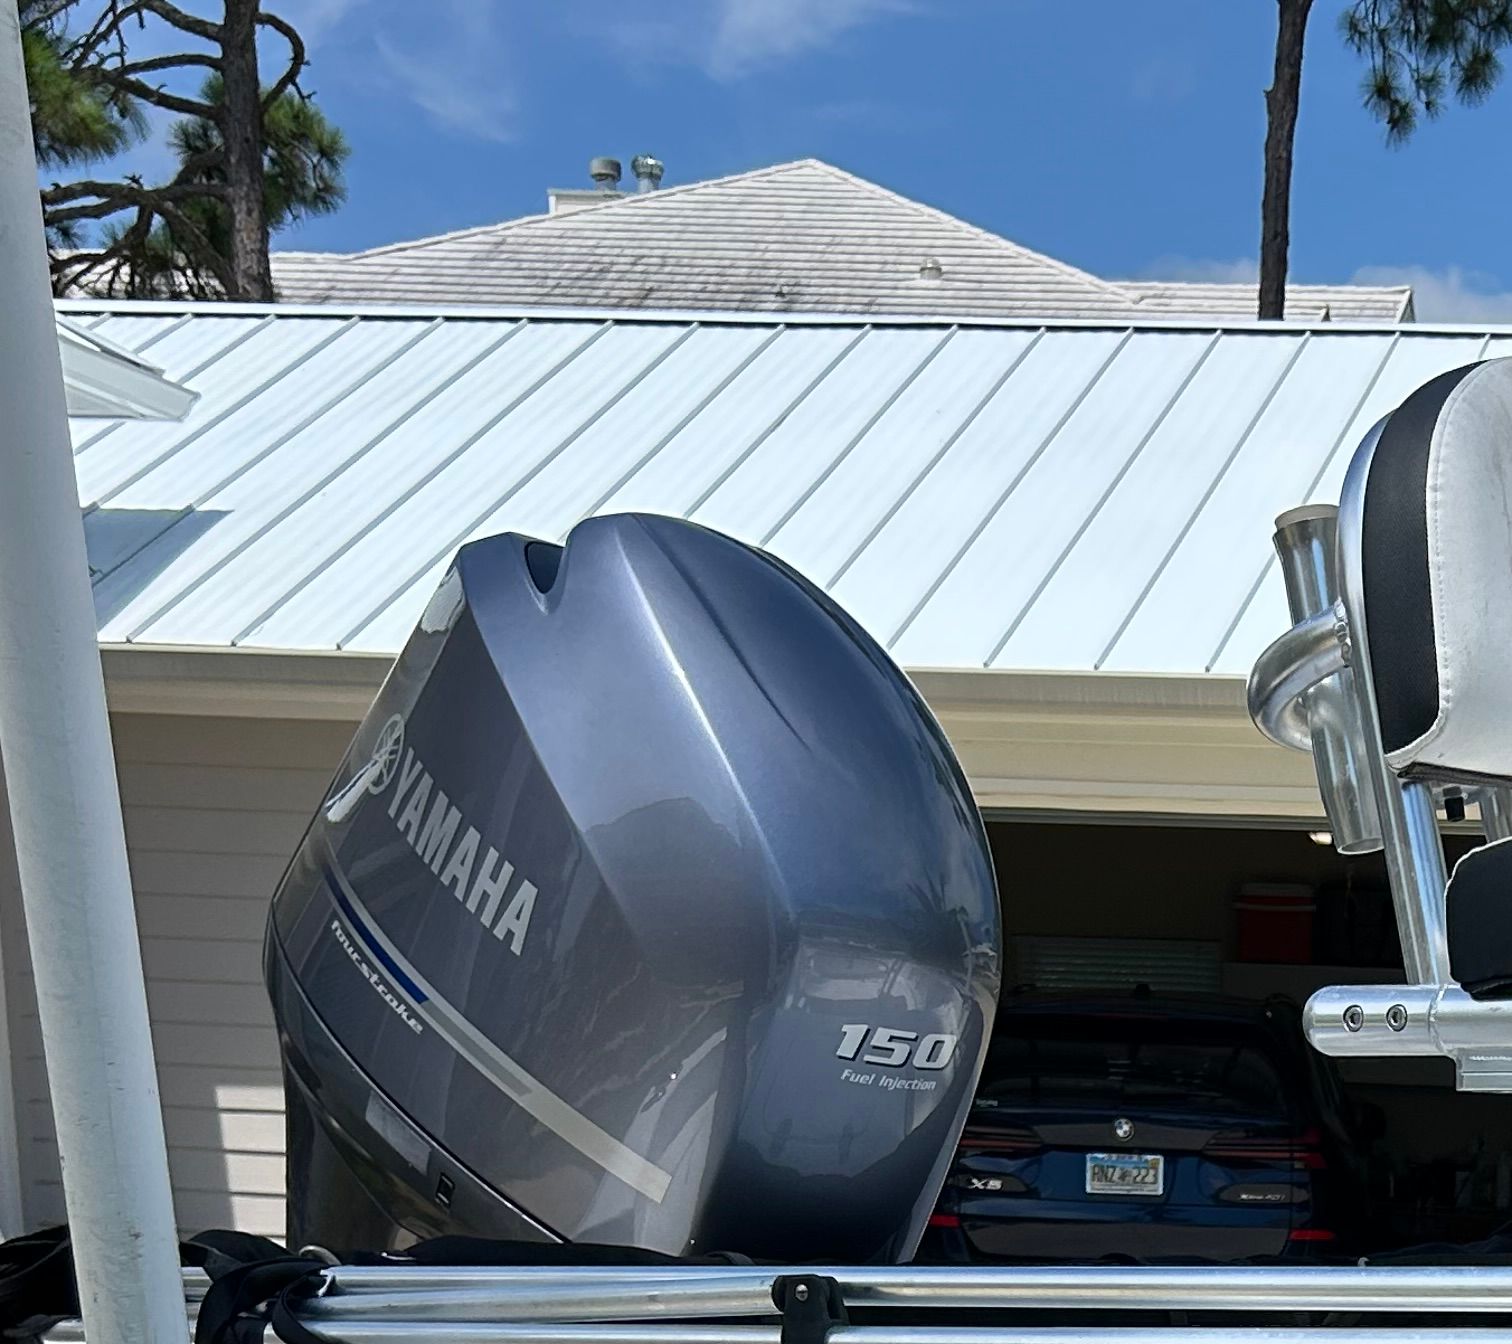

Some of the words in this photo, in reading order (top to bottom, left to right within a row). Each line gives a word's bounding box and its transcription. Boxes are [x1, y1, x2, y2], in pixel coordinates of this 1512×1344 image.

[386, 746, 539, 957] YAMAHA
[331, 919, 424, 1035] fourstroke
[835, 1024, 958, 1070] 150
[841, 1069, 876, 1085] Fuel
[878, 1075, 937, 1091] Injection
